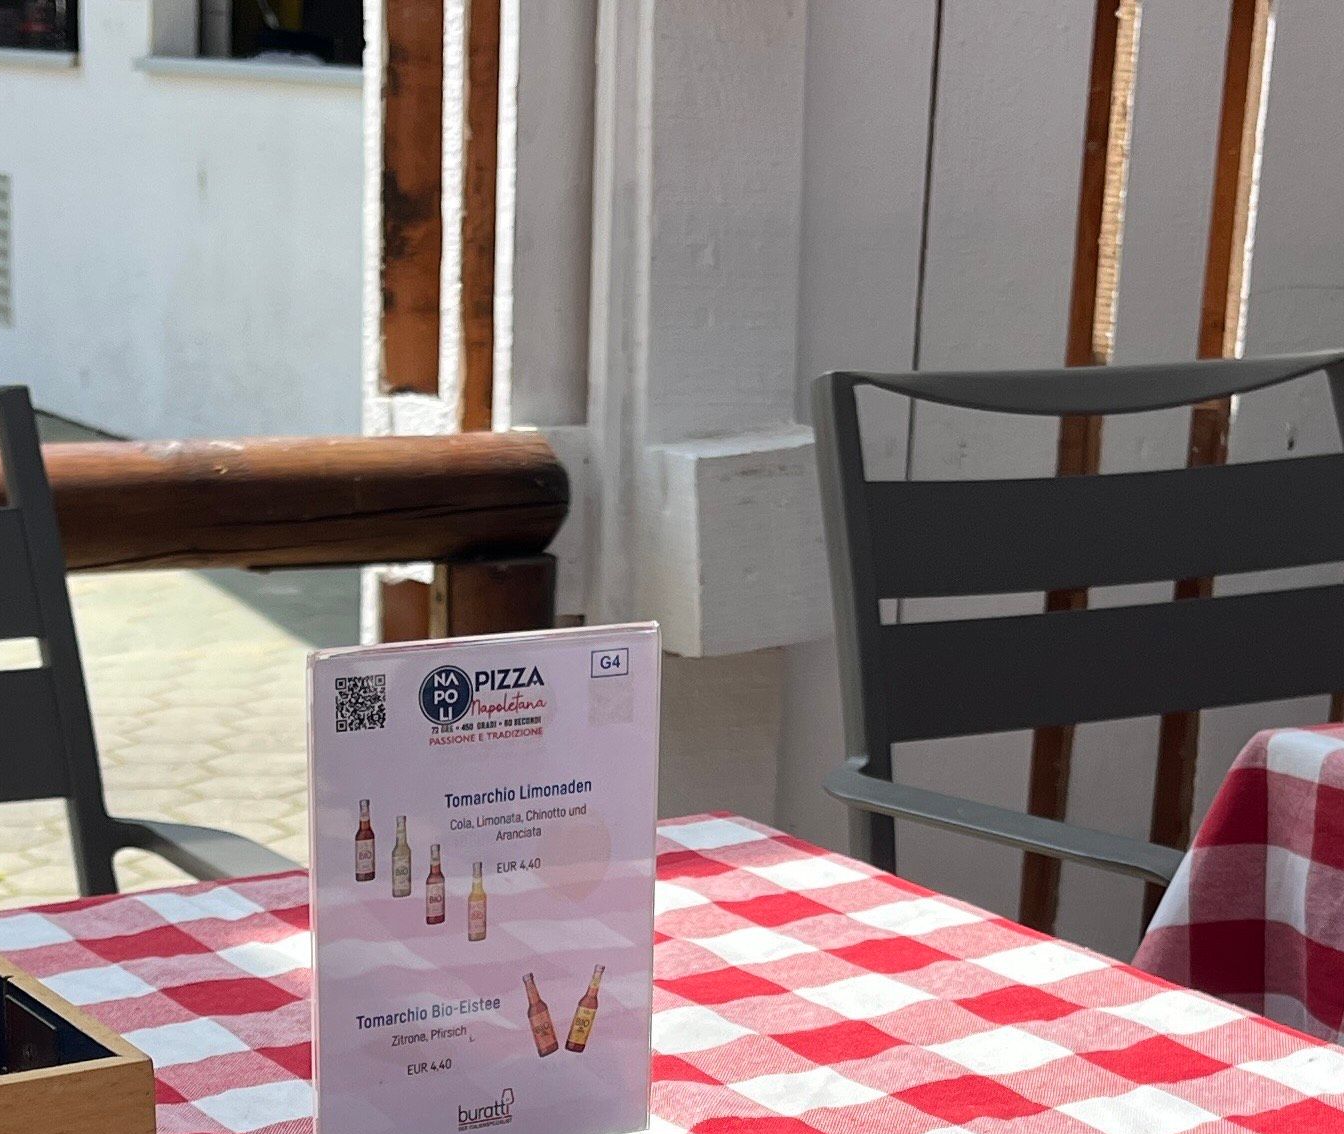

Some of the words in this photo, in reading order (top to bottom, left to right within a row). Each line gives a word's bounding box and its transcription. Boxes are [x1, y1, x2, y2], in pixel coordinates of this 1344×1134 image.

[600, 655, 621, 670] G4
[475, 666, 544, 692] PIZZA
[429, 734, 475, 746] PASSIONE
[478, 732, 485, 742] E
[487, 727, 543, 740] TRADIZIONE
[445, 788, 516, 808] Tomarchio
[519, 780, 592, 800] Limonaden
[450, 819, 475, 831] Cola,
[477, 813, 524, 828] Limonata,
[526, 808, 566, 822] Chinotto
[568, 804, 587, 817] und
[496, 827, 542, 841] Aranciata
[496, 862, 517, 874] EUR
[519, 858, 542, 872] 4,40
[356, 1007, 428, 1029] Tomarchio
[431, 998, 501, 1018] Bio-Eistee
[391, 1032, 428, 1047] Zitrone,
[430, 1025, 467, 1040] Pfirsich
[407, 1062, 429, 1076] EUR
[430, 1058, 453, 1072] 4,40
